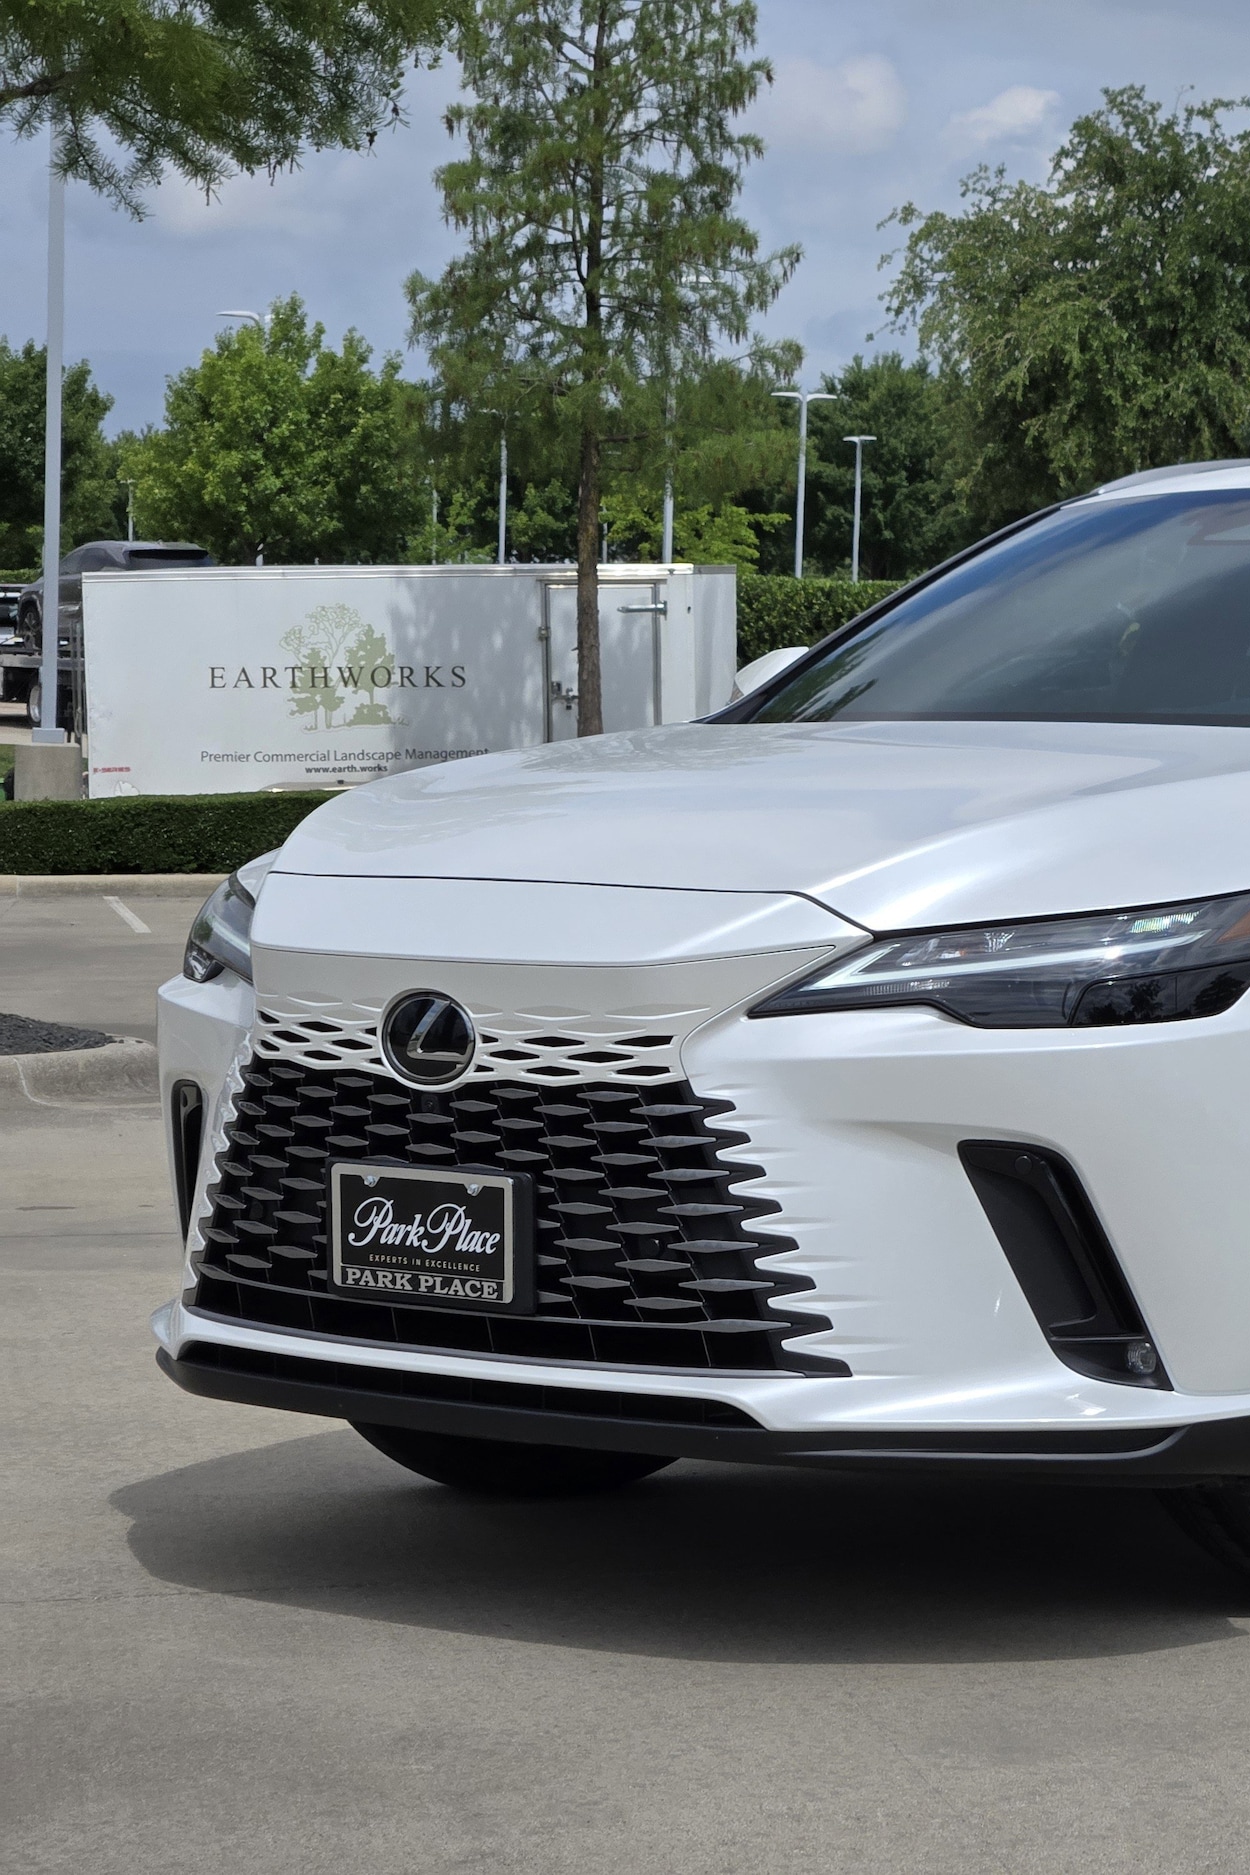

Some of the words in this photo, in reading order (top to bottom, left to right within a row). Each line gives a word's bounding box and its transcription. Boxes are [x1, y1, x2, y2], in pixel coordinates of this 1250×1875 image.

[208, 666, 467, 689] EARTHWORKS
[201, 750, 250, 763] Premier
[253, 749, 331, 763] Commercial
[334, 748, 402, 765] Landscape
[305, 764, 388, 774] www.earth.works
[348, 1197, 425, 1247] Park
[421, 1203, 501, 1254] Place
[369, 1254, 408, 1265] EXPERTS
[411, 1258, 422, 1267] IN
[425, 1259, 481, 1273] EXCELLENCE
[345, 1268, 414, 1291] PARK
[418, 1275, 499, 1300] PLACE
